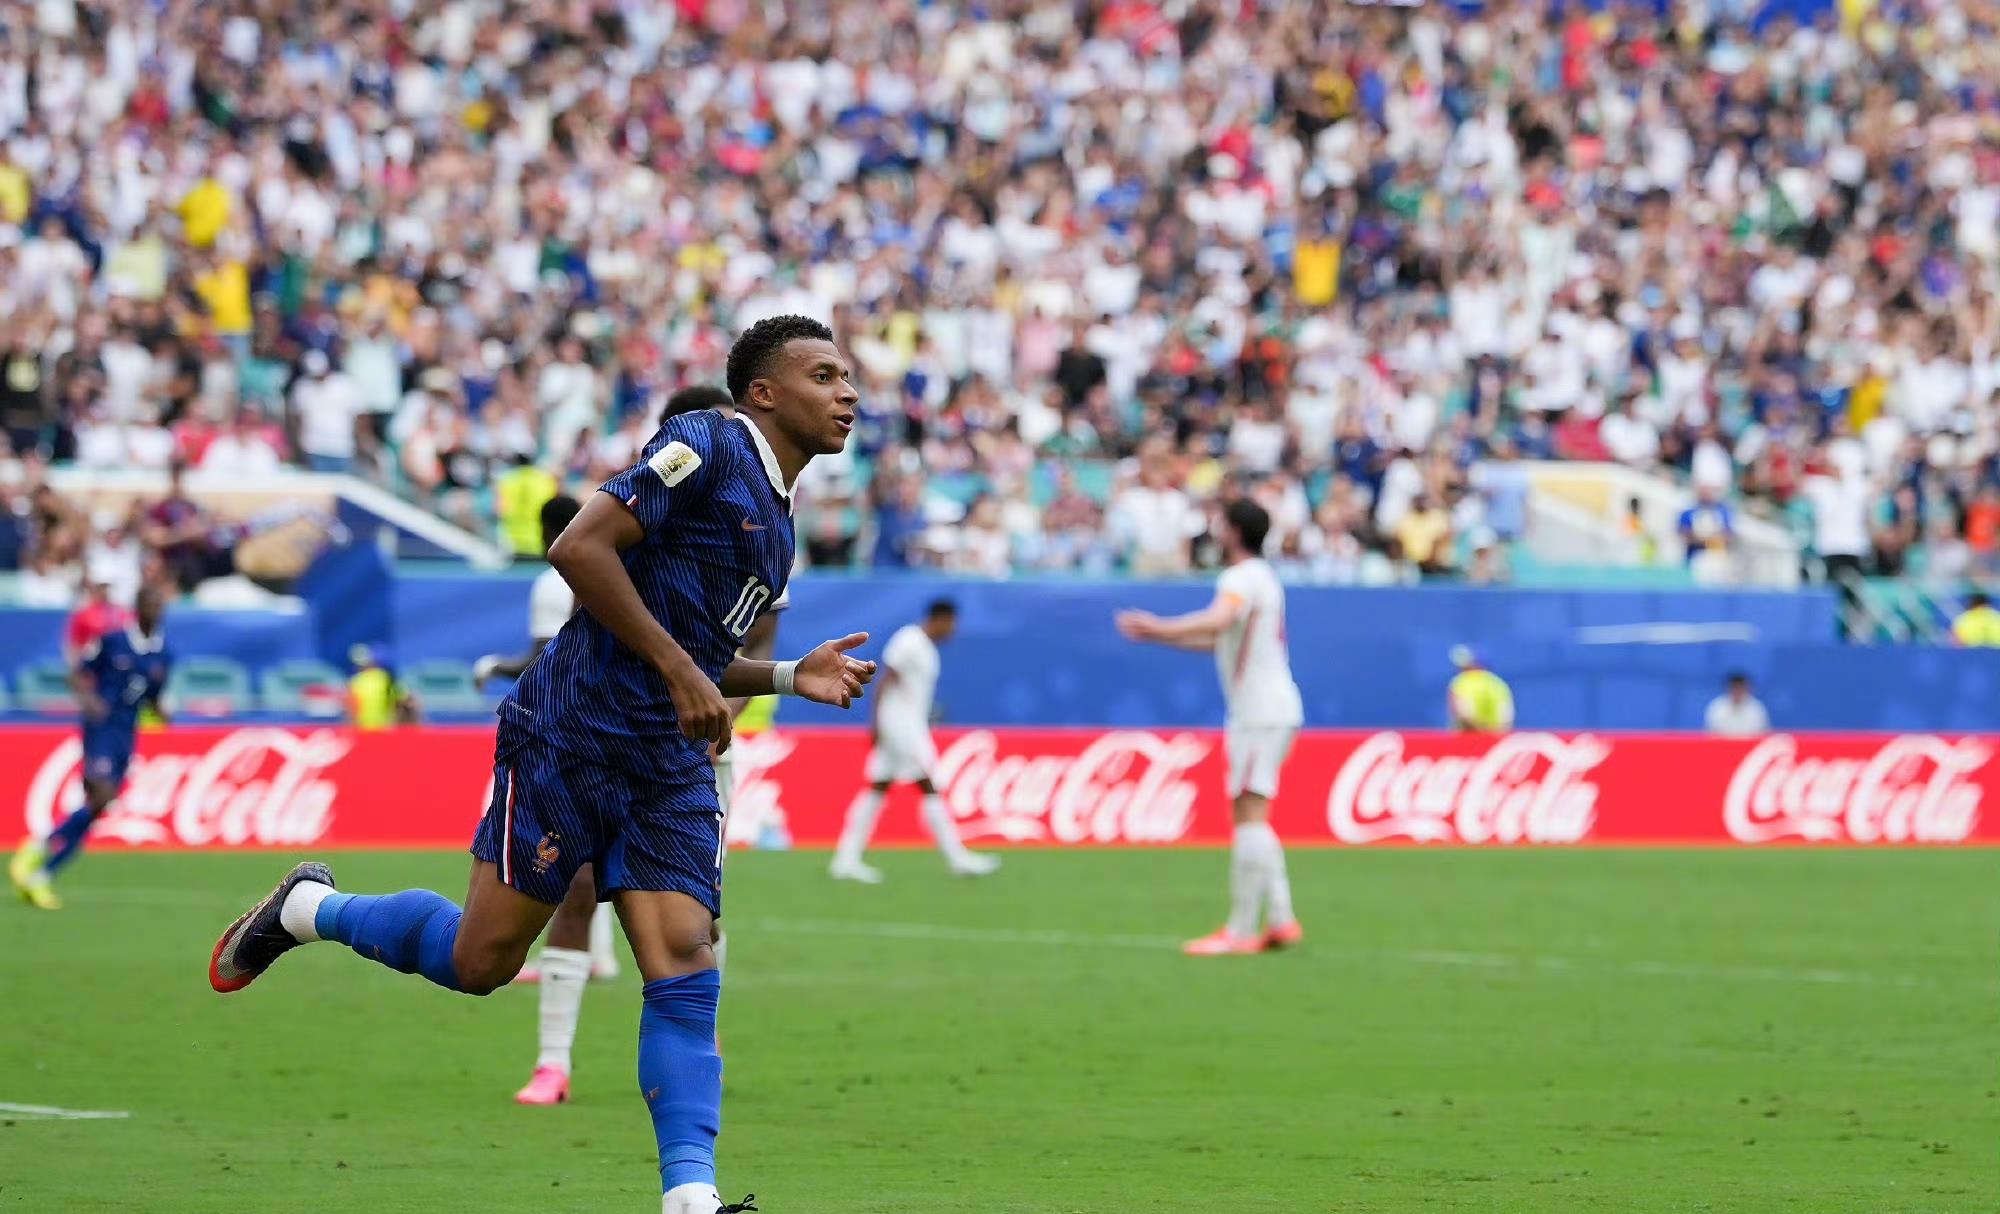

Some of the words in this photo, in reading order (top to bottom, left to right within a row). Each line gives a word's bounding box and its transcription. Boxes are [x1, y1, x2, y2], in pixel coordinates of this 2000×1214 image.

[722, 575, 771, 638] 10
[1327, 731, 1614, 844] Coca-Cola
[1722, 733, 1994, 843] Coca-Cola
